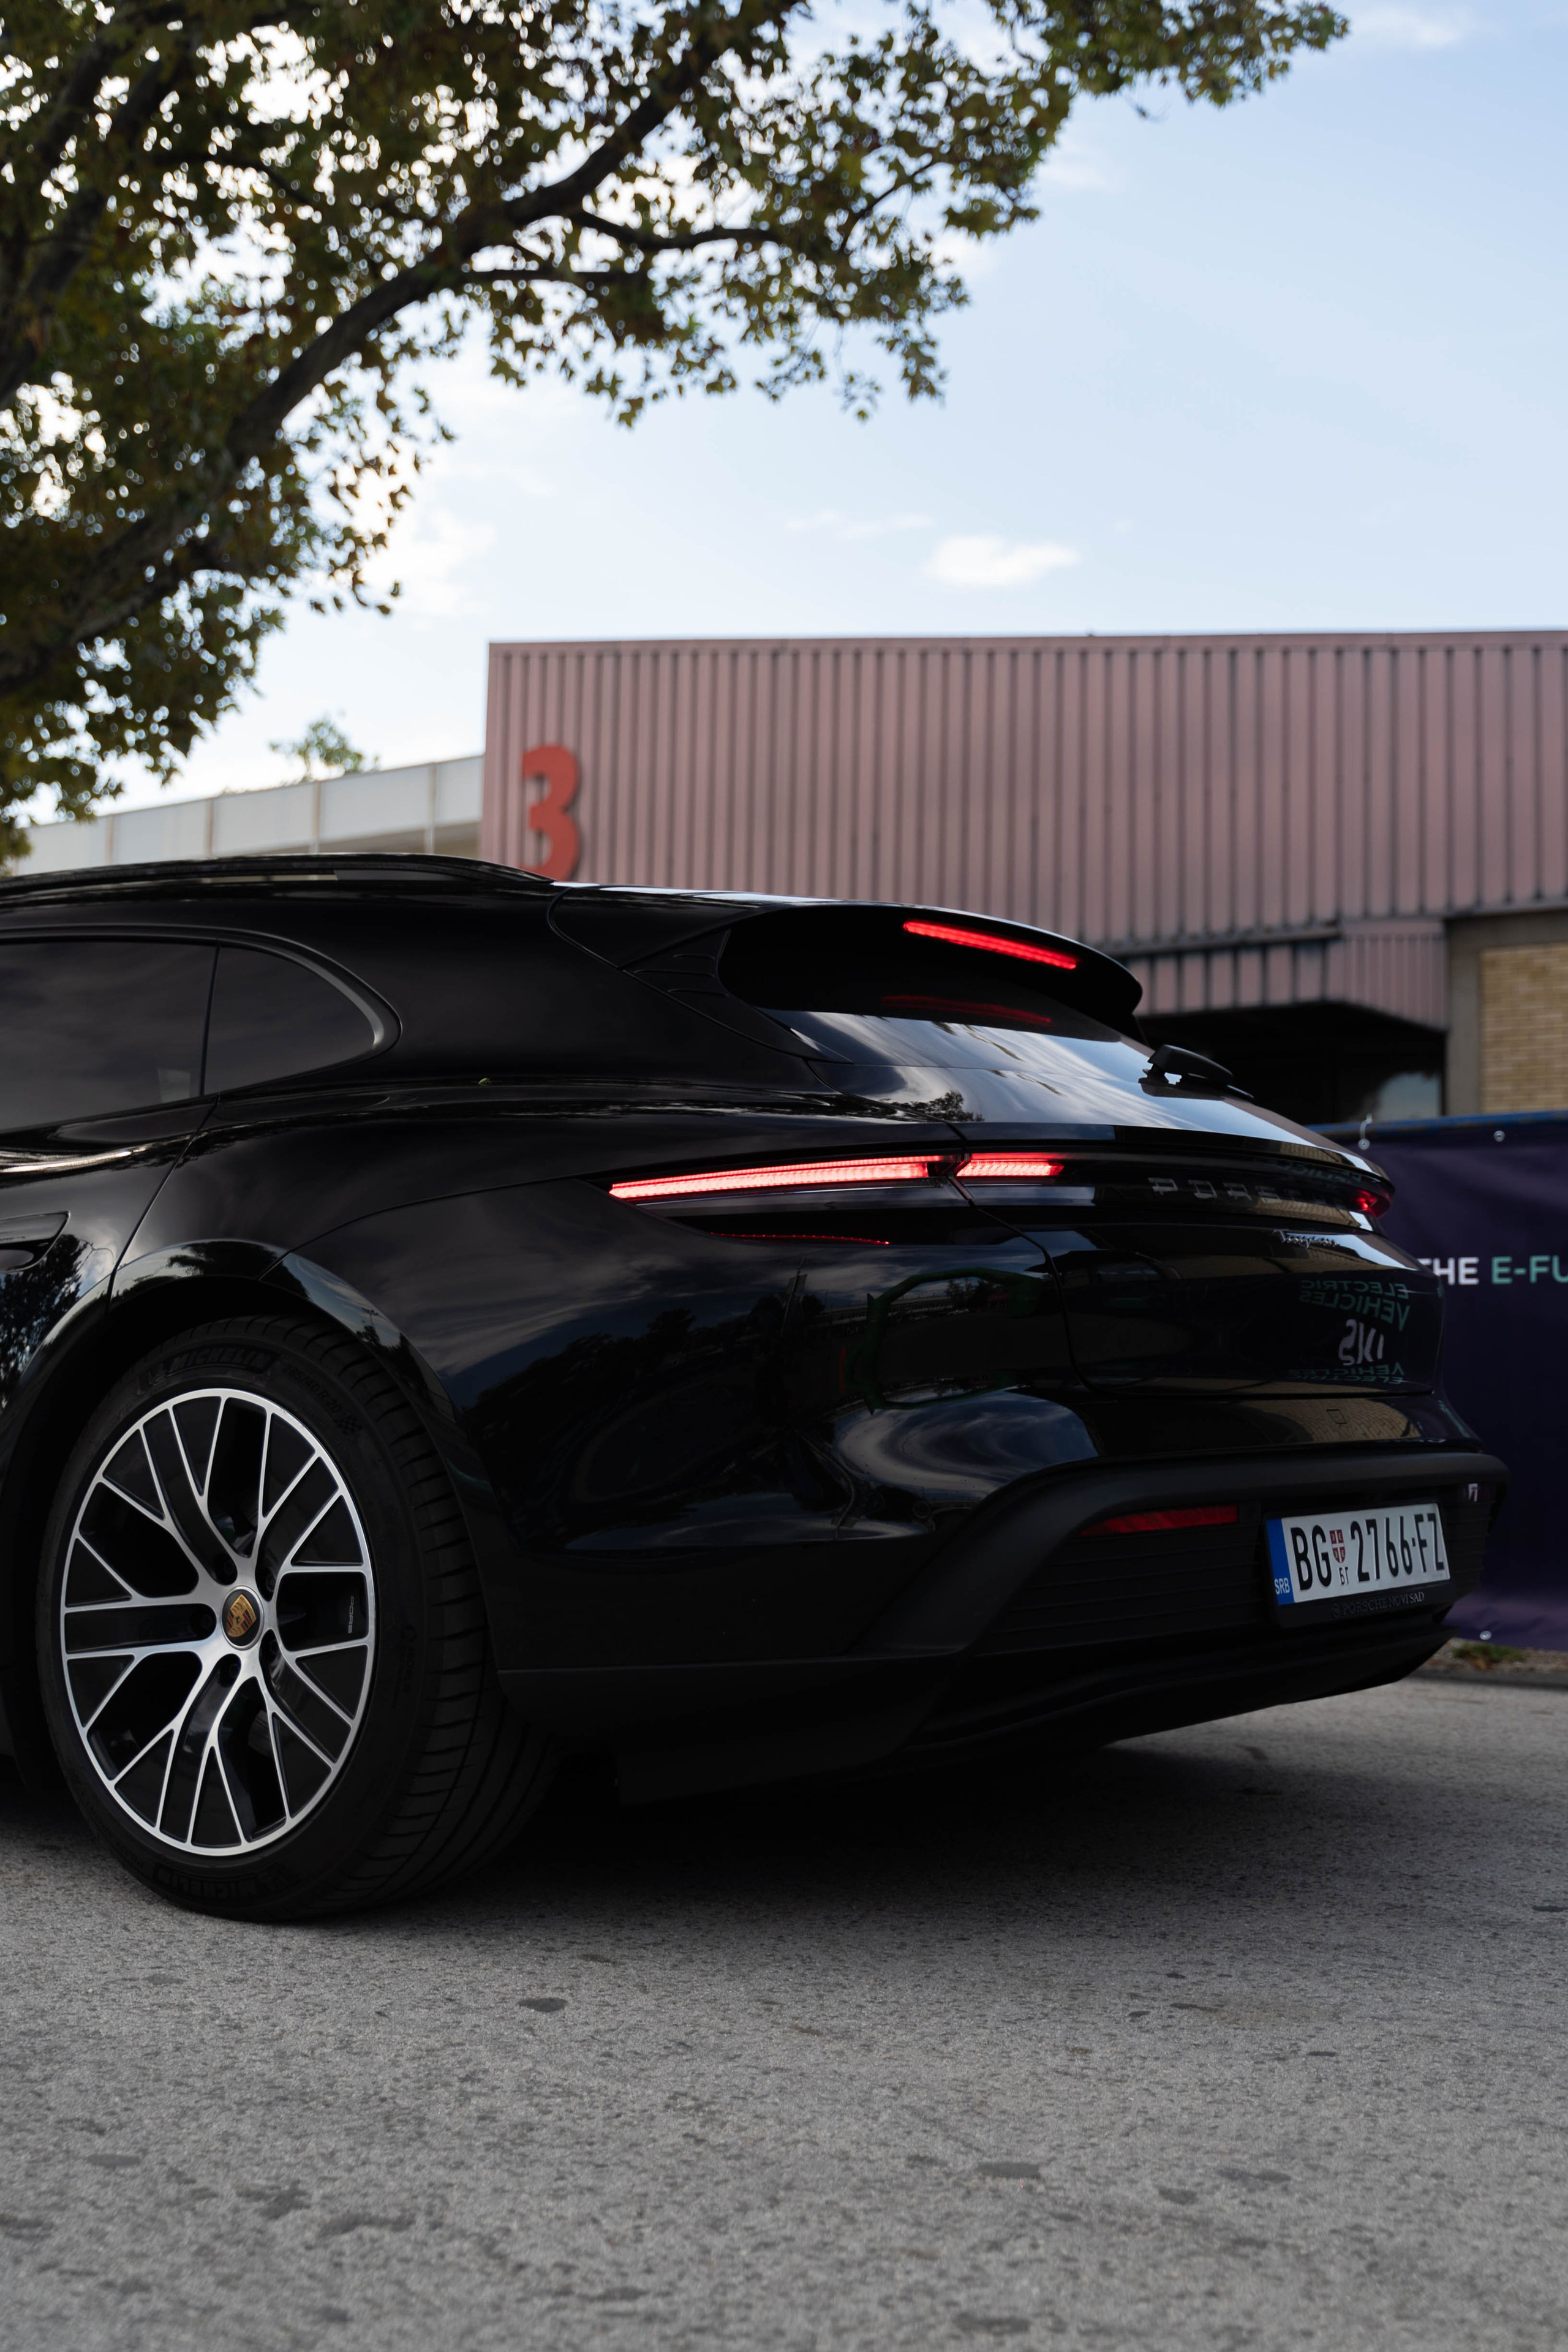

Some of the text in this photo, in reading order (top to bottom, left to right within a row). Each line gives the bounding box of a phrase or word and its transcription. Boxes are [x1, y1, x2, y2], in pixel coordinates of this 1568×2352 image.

[519, 744, 581, 882] 3
[168, 1348, 273, 1374] MICHELIN
[1291, 1525, 1332, 1591] BG
[1274, 1577, 1291, 1595] SRB
[1343, 1591, 1425, 1615] PORSCHE NOVI SAD
[157, 1868, 258, 1898] MICHELIN
